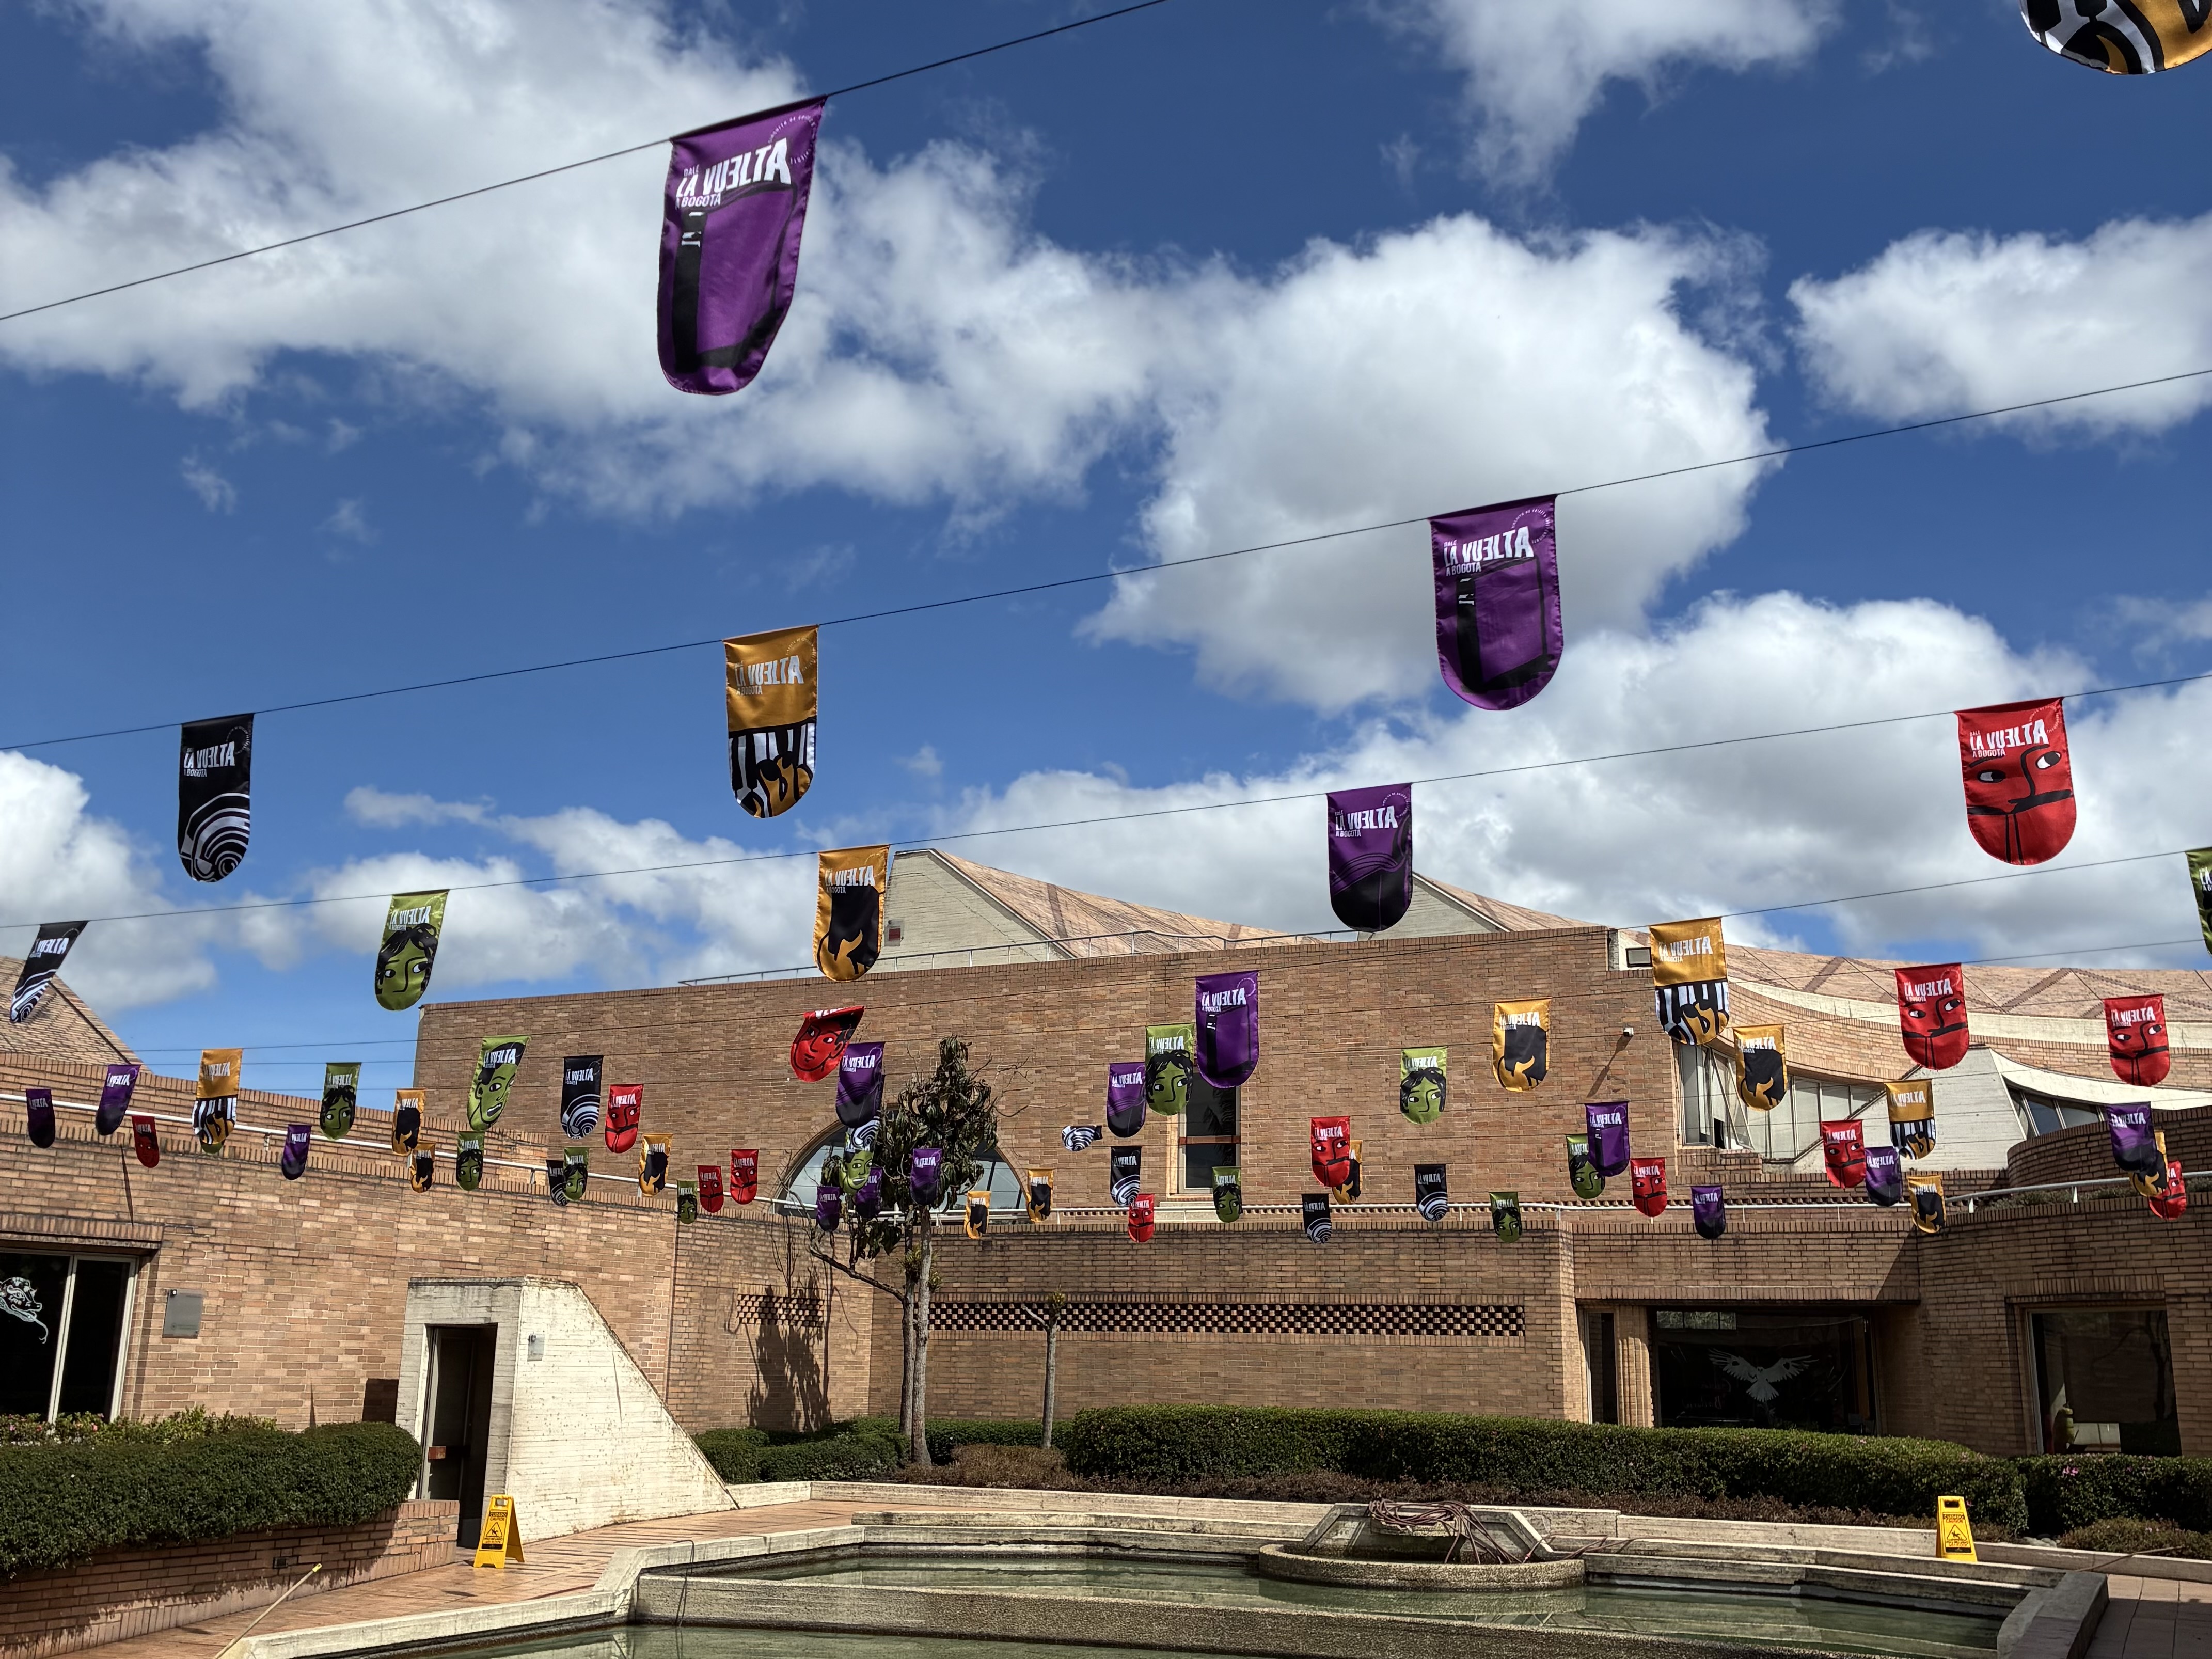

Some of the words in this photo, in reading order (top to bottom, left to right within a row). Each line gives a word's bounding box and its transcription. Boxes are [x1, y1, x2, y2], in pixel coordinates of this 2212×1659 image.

[676, 175, 698, 197] LA
[703, 137, 791, 195] VUELTA
[684, 165, 699, 177] DALE
[1444, 545, 1458, 566] LA
[1462, 526, 1534, 563] VUELTA
[1446, 567, 1451, 577] A
[1451, 562, 1482, 575] BOGOTA
[735, 667, 746, 686] LA
[748, 655, 804, 685] VUELTA
[1970, 735, 1984, 750] LA
[1986, 719, 2049, 749] VUELTA
[184, 752, 194, 768] LA
[197, 741, 235, 768] VUELTA
[1335, 815, 1345, 830] LA
[1347, 805, 1398, 829] VUELTA
[835, 865, 875, 886] VUELTA
[1670, 936, 1713, 956] VUELTA
[1202, 994, 1209, 1006] LA
[1212, 987, 1246, 1006] VUELTA
[1904, 984, 1913, 997] LA
[1914, 978, 1953, 996] VUELTA
[1508, 1012, 1541, 1026] VUELTA
[2120, 1006, 2156, 1022] VUELTA
[1157, 1036, 1184, 1050] VUELTA
[849, 1055, 875, 1068] VUELTA
